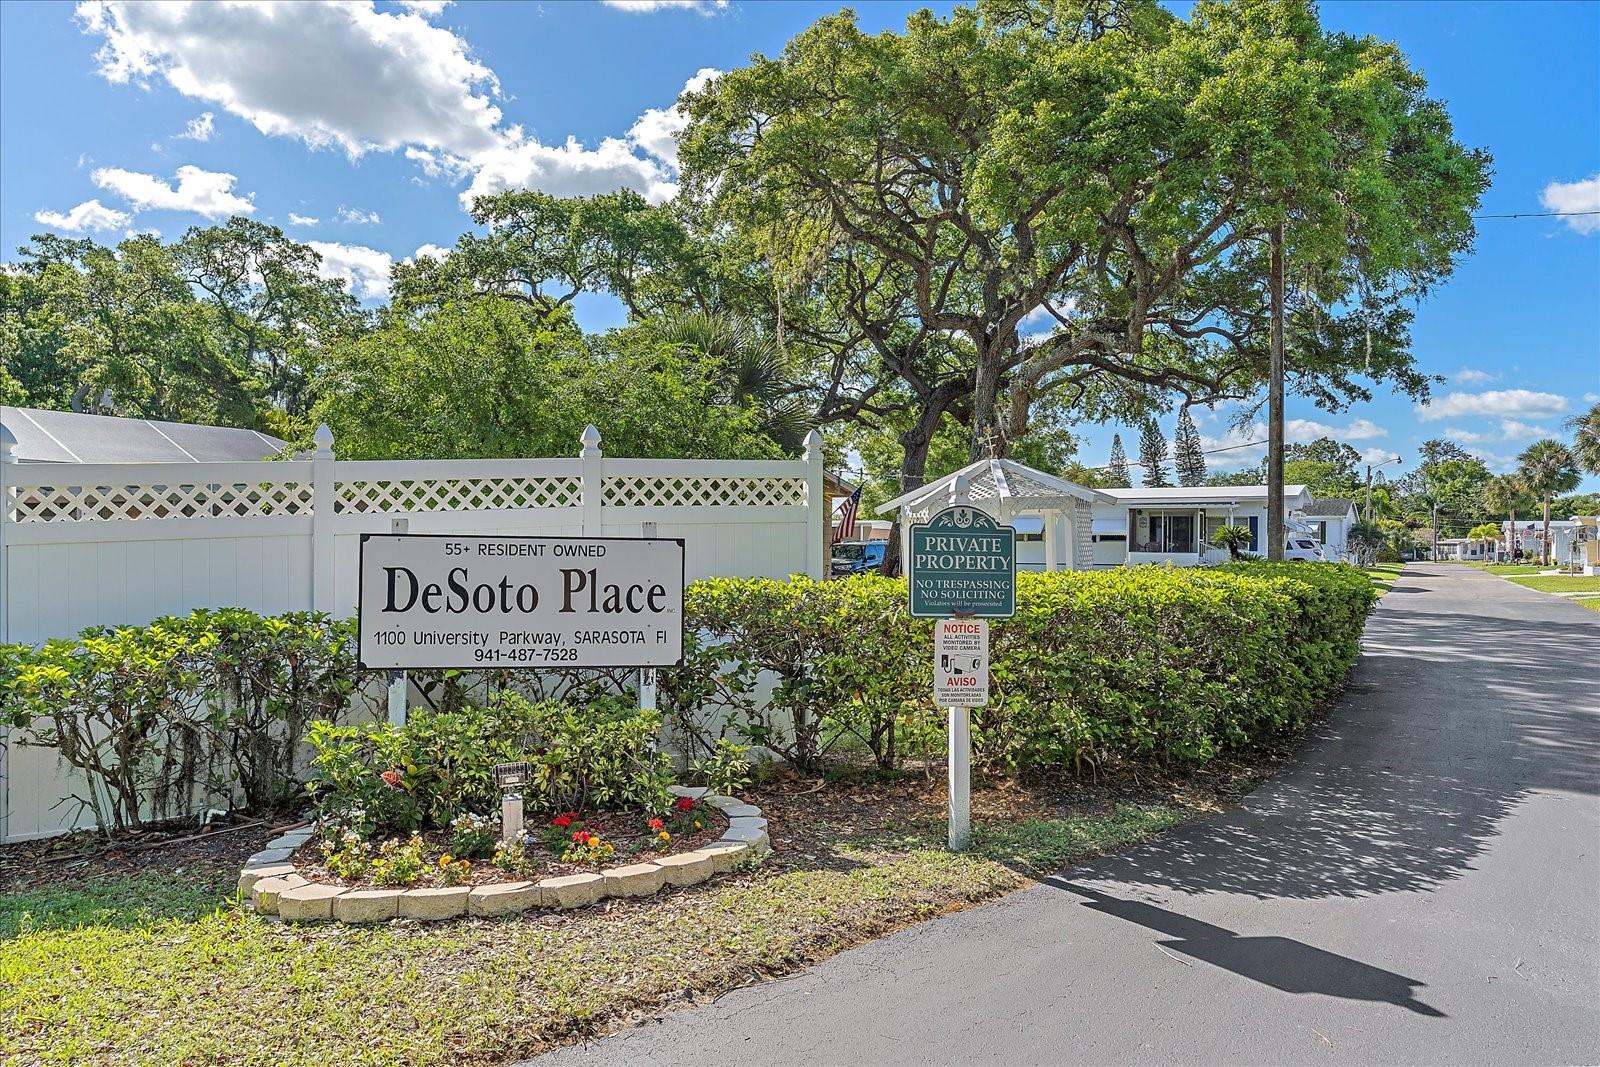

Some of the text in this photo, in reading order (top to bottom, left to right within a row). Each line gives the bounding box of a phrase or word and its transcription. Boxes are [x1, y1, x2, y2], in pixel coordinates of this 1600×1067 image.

[446, 543, 606, 557] 55+ RESIDENT OWNED
[925, 537, 1001, 552] PRIVATE
[915, 554, 1010, 570] PROPERTY
[382, 566, 538, 613] DeSoto
[559, 568, 666, 613] Place
[916, 580, 1009, 589] NO TRESPASSING
[921, 590, 1005, 599] NO SOLICITING
[944, 624, 980, 633] NOTICE
[374, 632, 406, 645] 1100
[414, 630, 488, 647] University
[500, 630, 566, 647] Parkway,
[574, 630, 645, 644] SARASOTA
[474, 649, 578, 662] 941-487-7528
[947, 677, 976, 686] AVISO
